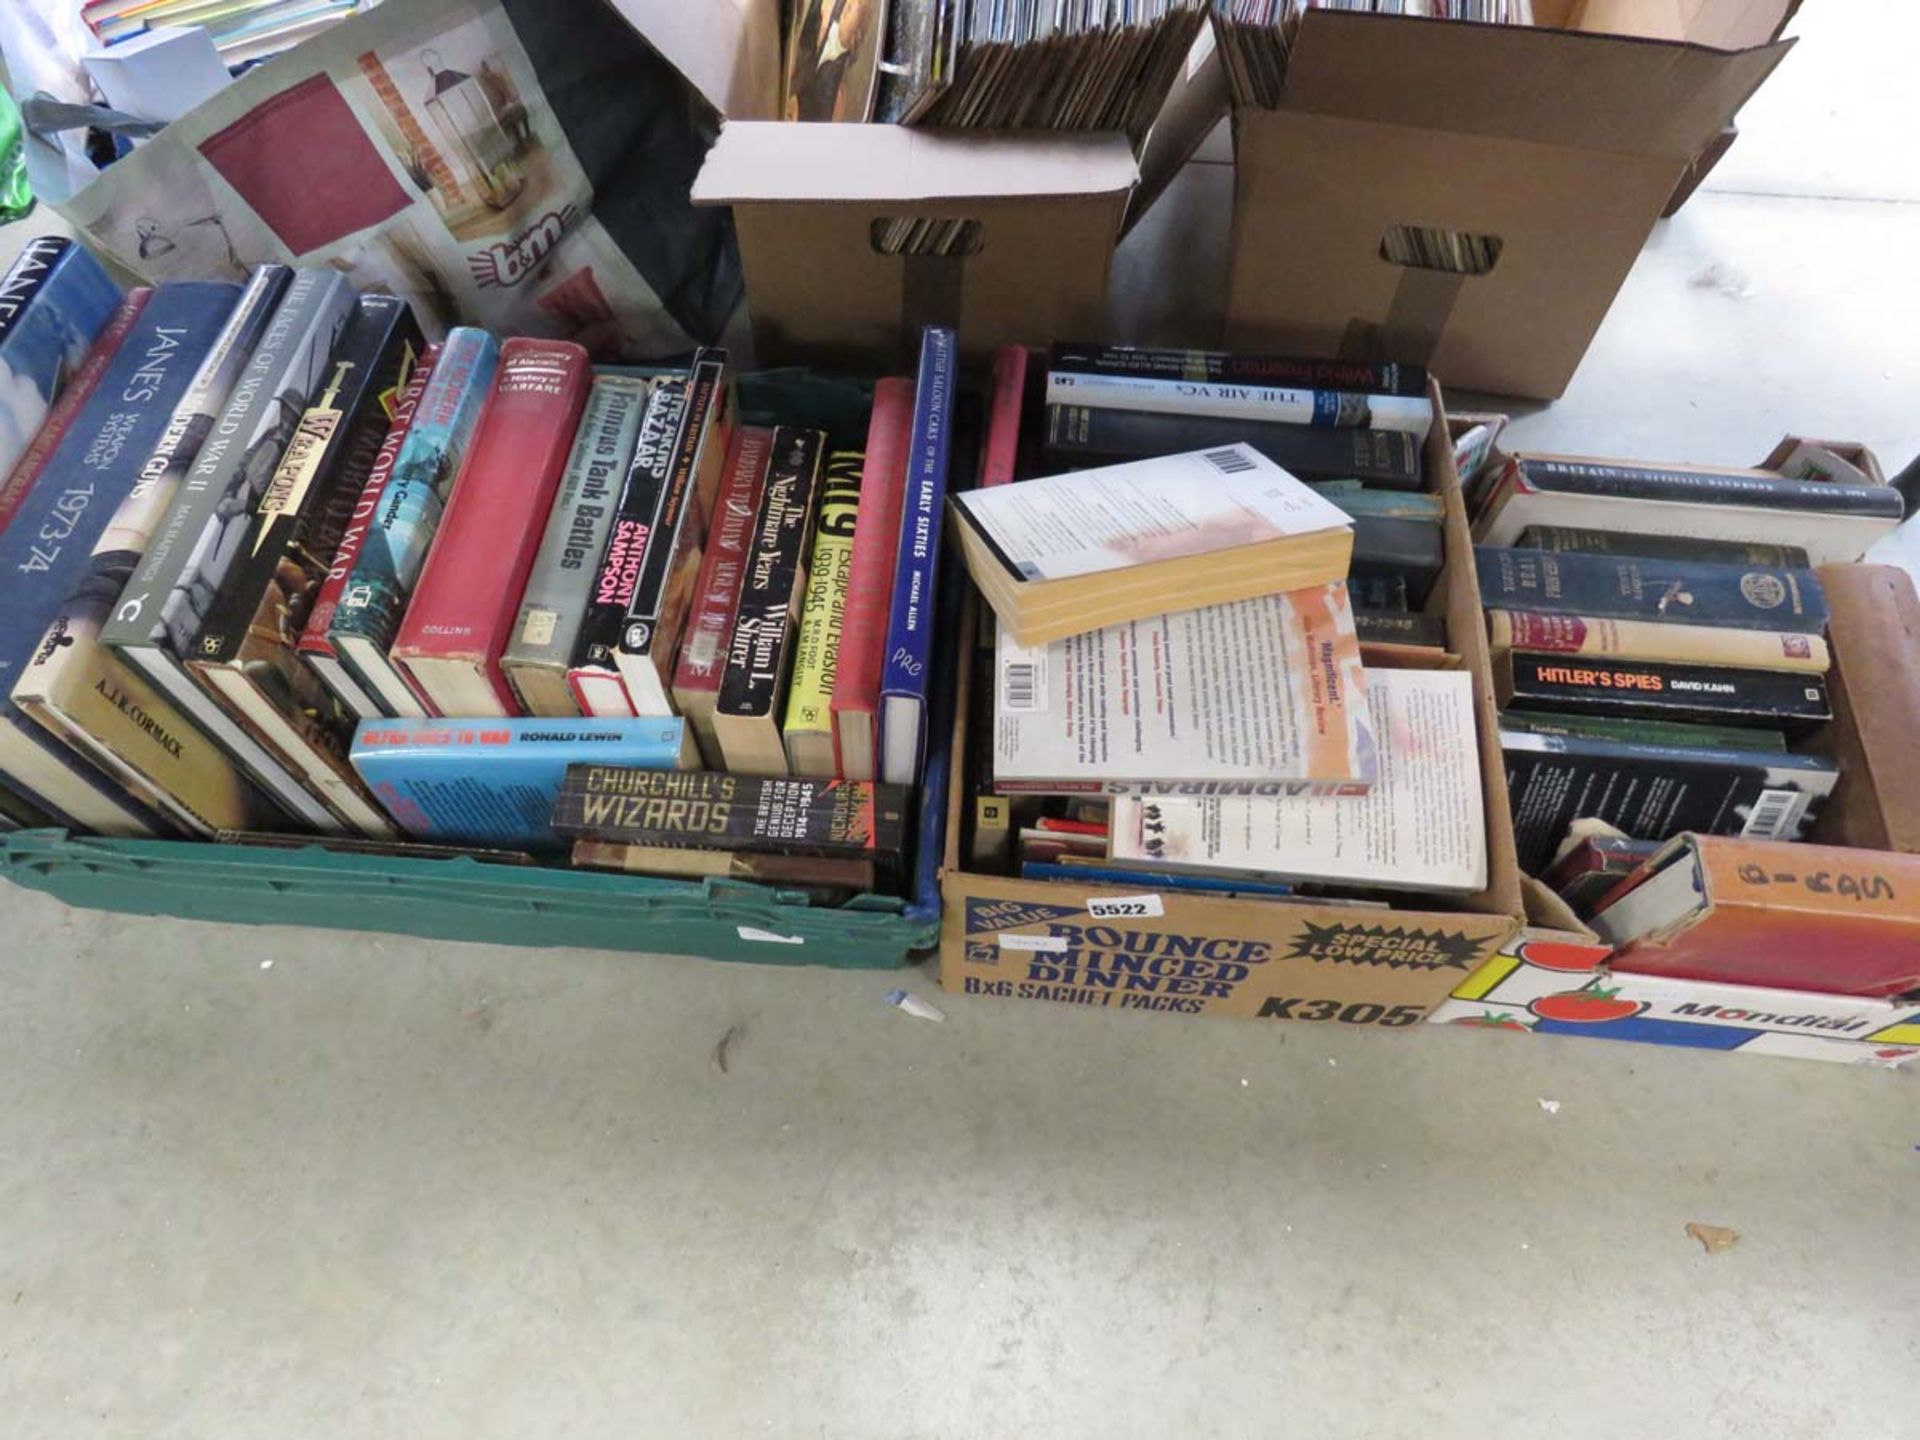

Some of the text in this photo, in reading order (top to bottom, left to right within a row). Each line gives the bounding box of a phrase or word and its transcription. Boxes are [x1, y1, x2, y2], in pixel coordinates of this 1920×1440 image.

[489, 211, 564, 287] b&m
[269, 308, 298, 351] FACES
[123, 326, 188, 402] JANE'S
[258, 354, 278, 375] OF
[219, 377, 261, 434] WORLD
[931, 375, 945, 412] SALOON
[1176, 384, 1210, 398] VCs
[1217, 388, 1251, 400] AIR
[1260, 390, 1298, 403] THE
[84, 413, 117, 466] SYSTEMS
[100, 413, 140, 470] WEAPON
[596, 388, 637, 457] Famous
[633, 390, 667, 469] BAZAAR
[927, 414, 940, 440] CARS
[199, 438, 231, 473] WAR
[327, 366, 430, 584] FIRST WORLD WAR
[1546, 462, 1617, 479] BRITAIN
[130, 459, 168, 499] GUNS
[581, 460, 619, 502] Tank
[919, 480, 934, 512] EARLY
[18, 482, 95, 574] 1973-74
[382, 491, 408, 532] Gander
[784, 503, 806, 529] The
[561, 503, 604, 571] Battles
[752, 475, 798, 592] Nightmare Years
[914, 516, 930, 557] SIXTIES
[597, 520, 626, 604] SAMPSON
[618, 522, 650, 607] ANTHONY
[806, 548, 832, 613] 1939-1945
[907, 570, 921, 631] MICHAEL ALLEN
[819, 548, 852, 695] Escape and Evasion
[729, 616, 752, 669] Shirer
[749, 602, 788, 690] William L.
[807, 645, 818, 669] FOOT
[1537, 666, 1664, 692] HITLER'S SPIES
[1703, 681, 1736, 694] KAHN
[520, 732, 623, 742] RONALD LEWIN
[587, 768, 737, 800] CHURCHILL'S
[1107, 780, 1308, 797] ADMIRALS
[583, 793, 732, 834] WIZARDS
[754, 780, 773, 836] THE BRITISH
[768, 780, 787, 838] GENIUS FOR
[780, 781, 800, 838] DECEPTION
[829, 783, 849, 842] NICHOLAS
[973, 901, 1023, 918] BIG
[974, 908, 1059, 930] VALUE
[1091, 904, 1148, 917] 5522
[1047, 923, 1271, 965] BOUNCE
[1308, 944, 1453, 964] LOW PRICE
[1330, 933, 1440, 952] SPECIAL
[1026, 962, 1235, 998] DINNER
[1032, 949, 1249, 983] MINCED
[964, 976, 1205, 1015] 8x6 SACHET PACKS
[1255, 996, 1428, 1028] K305
[1671, 1001, 1872, 1033] Mondial
